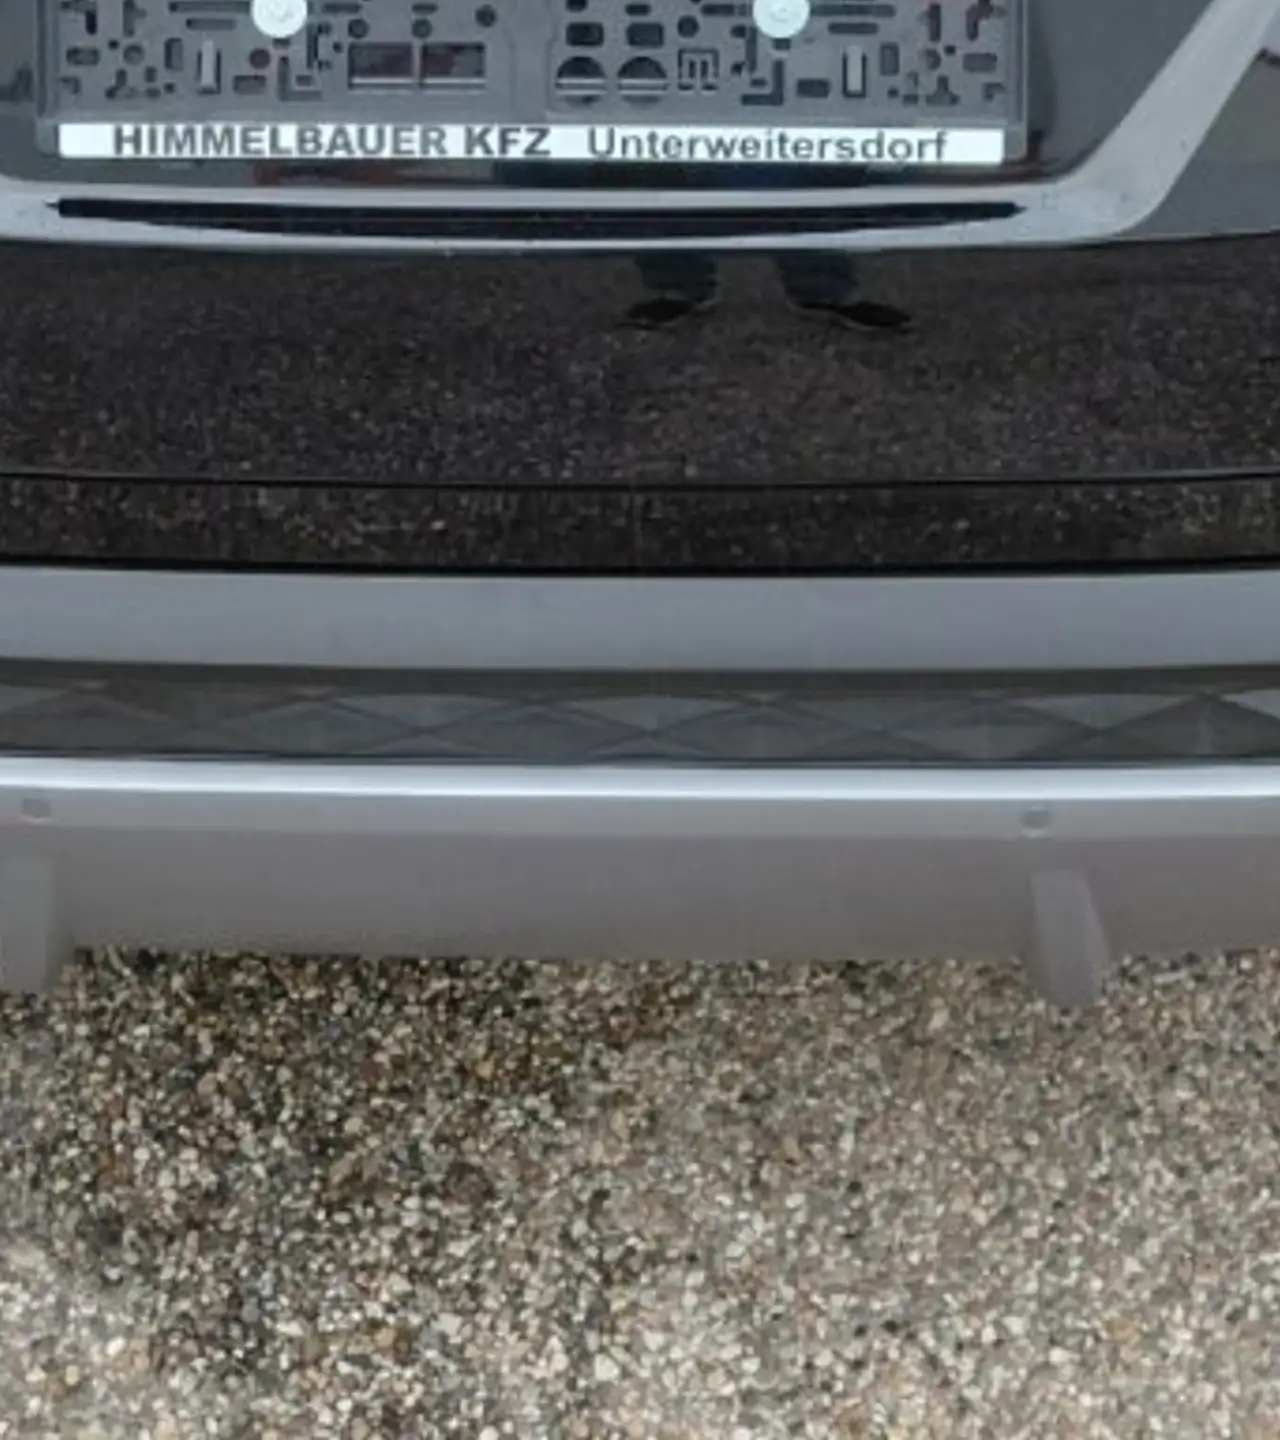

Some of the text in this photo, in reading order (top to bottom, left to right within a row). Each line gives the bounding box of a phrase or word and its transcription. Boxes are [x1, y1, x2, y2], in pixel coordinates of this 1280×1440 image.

[113, 124, 949, 161] HIMMELBAUER KFZ Unterweitersdorf
